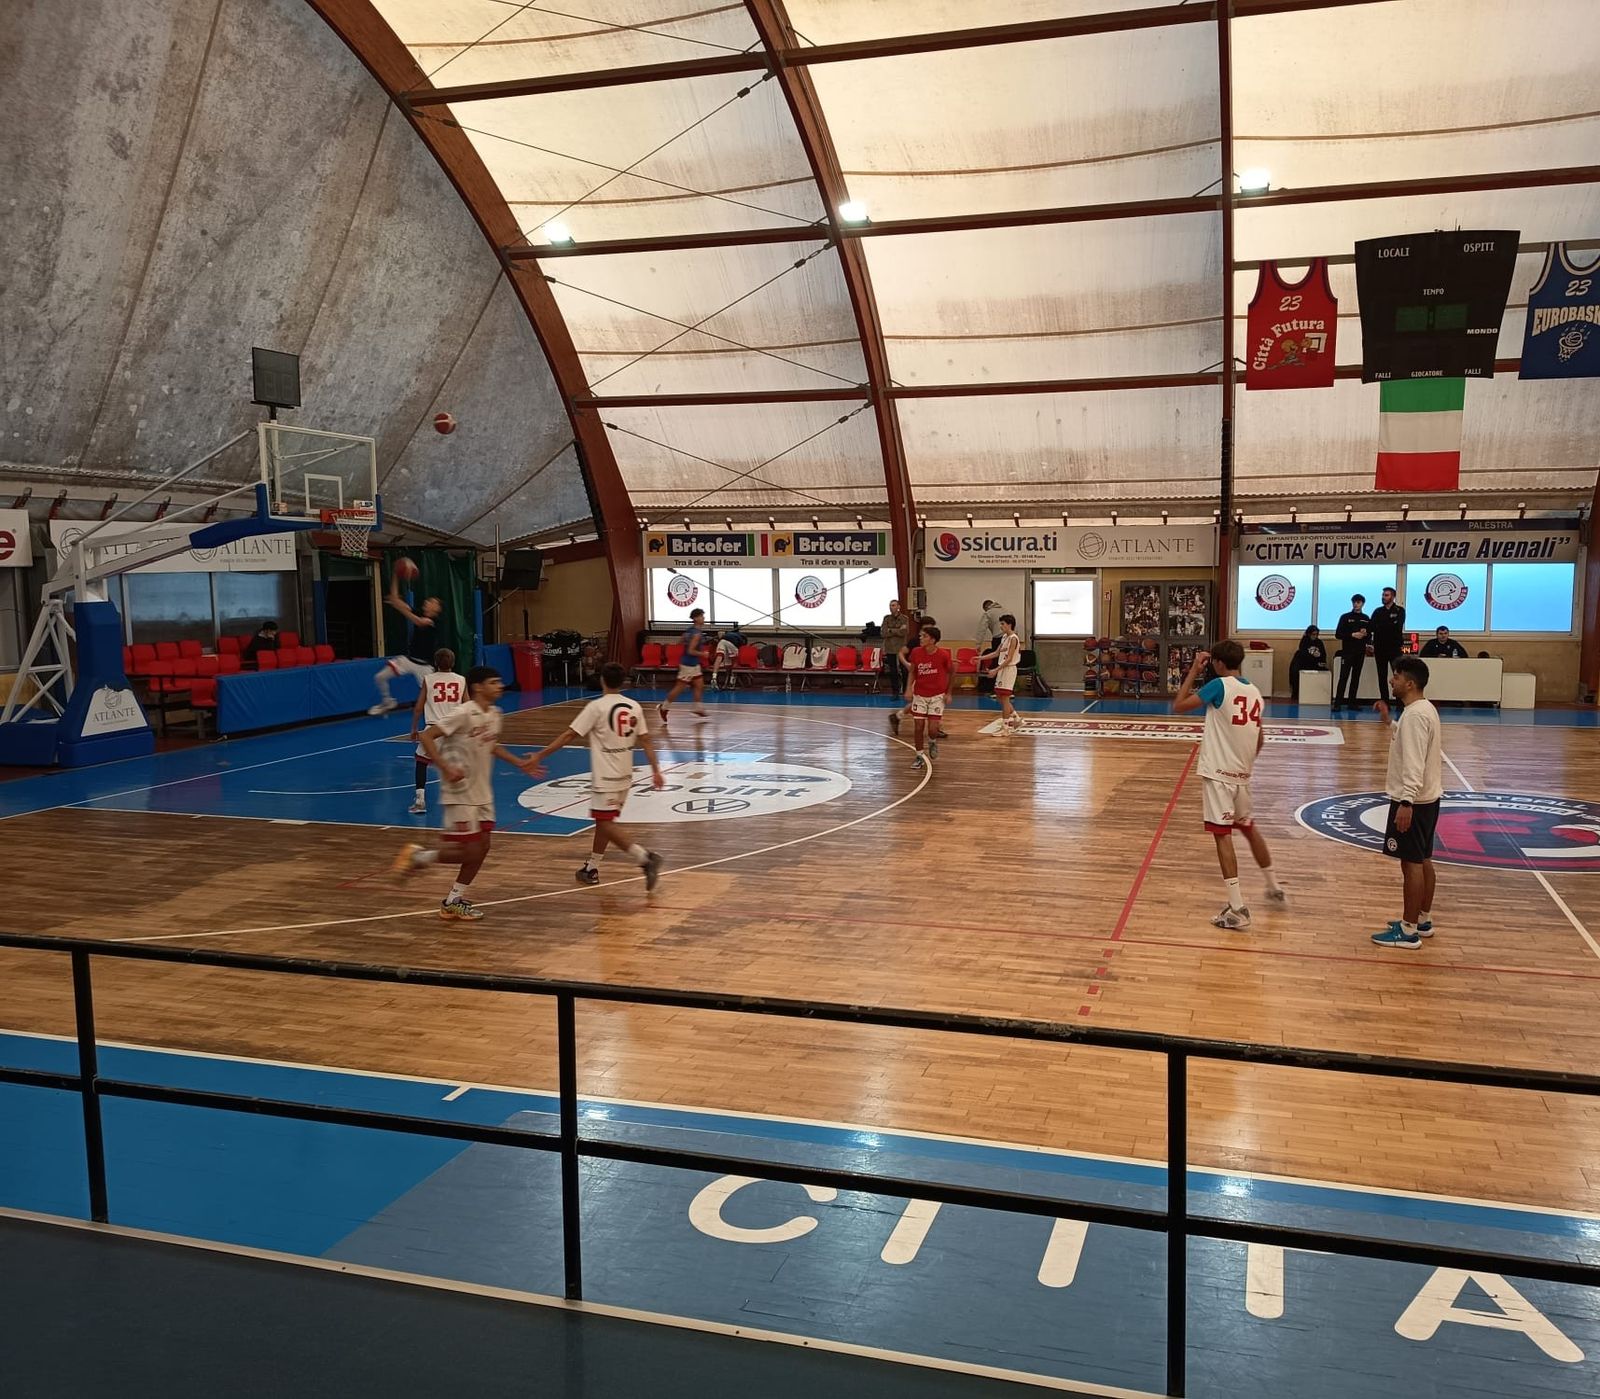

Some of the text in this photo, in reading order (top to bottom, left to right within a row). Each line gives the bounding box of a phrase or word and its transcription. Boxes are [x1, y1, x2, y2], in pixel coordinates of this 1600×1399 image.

[1378, 247, 1410, 259] LOCALI
[1463, 241, 1495, 253] OSPITI
[1423, 288, 1445, 296] TEMPO
[1565, 279, 1592, 297] 23
[1279, 295, 1303, 312] 23
[1252, 318, 1325, 371] Città Futura
[1468, 521, 1514, 530] PALESTRA
[219, 538, 292, 555] ATLANTE
[671, 537, 742, 553] Bricofer
[799, 536, 872, 552] Bricofer
[1109, 538, 1195, 553] ATLANTE
[433, 682, 459, 703] 33
[92, 706, 136, 722] ATLANTE
[1231, 695, 1261, 728] 34
[546, 779, 810, 798] Crpoint
[1321, 797, 1383, 820] FUTURA
[1497, 803, 1569, 814] ROMA
